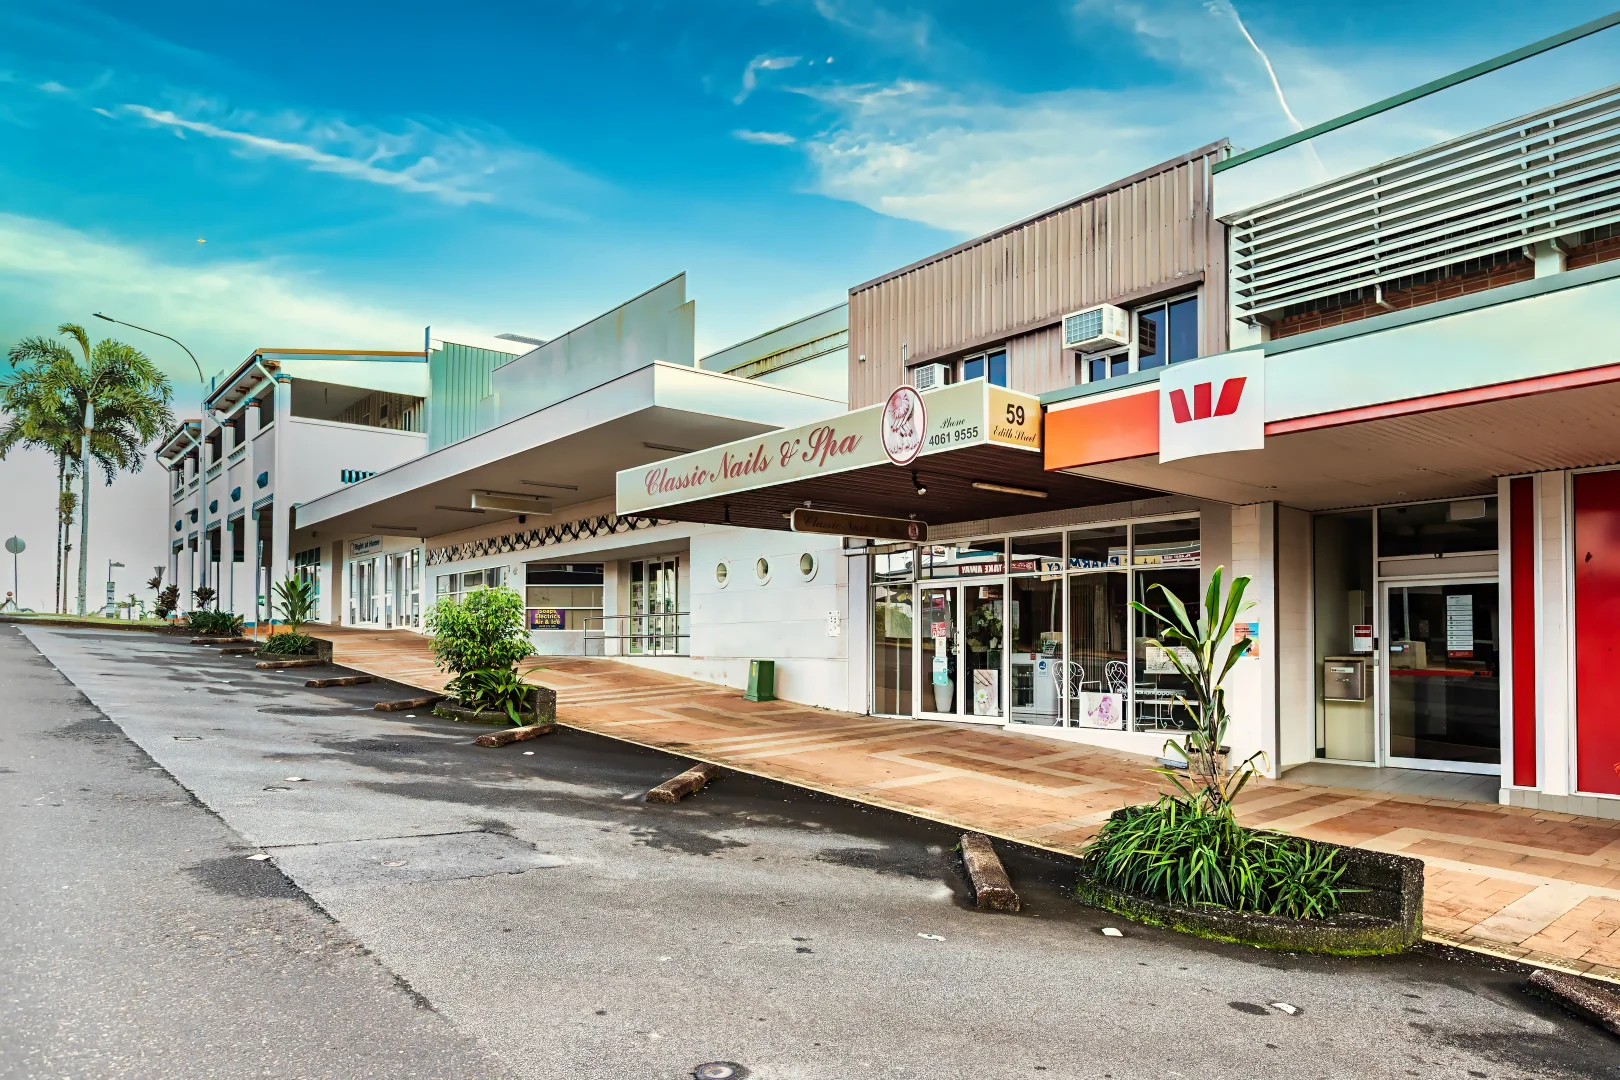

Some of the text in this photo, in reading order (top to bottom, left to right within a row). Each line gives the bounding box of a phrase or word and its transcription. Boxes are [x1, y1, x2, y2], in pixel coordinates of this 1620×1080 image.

[940, 417, 965, 429] Phone
[1006, 403, 1025, 426] 59
[928, 426, 979, 446] 4061 9555
[993, 425, 1037, 442] Edith Street
[645, 425, 863, 496] Classic Nails & Spa
[803, 515, 841, 530] Classic
[354, 543, 364, 551] Right
